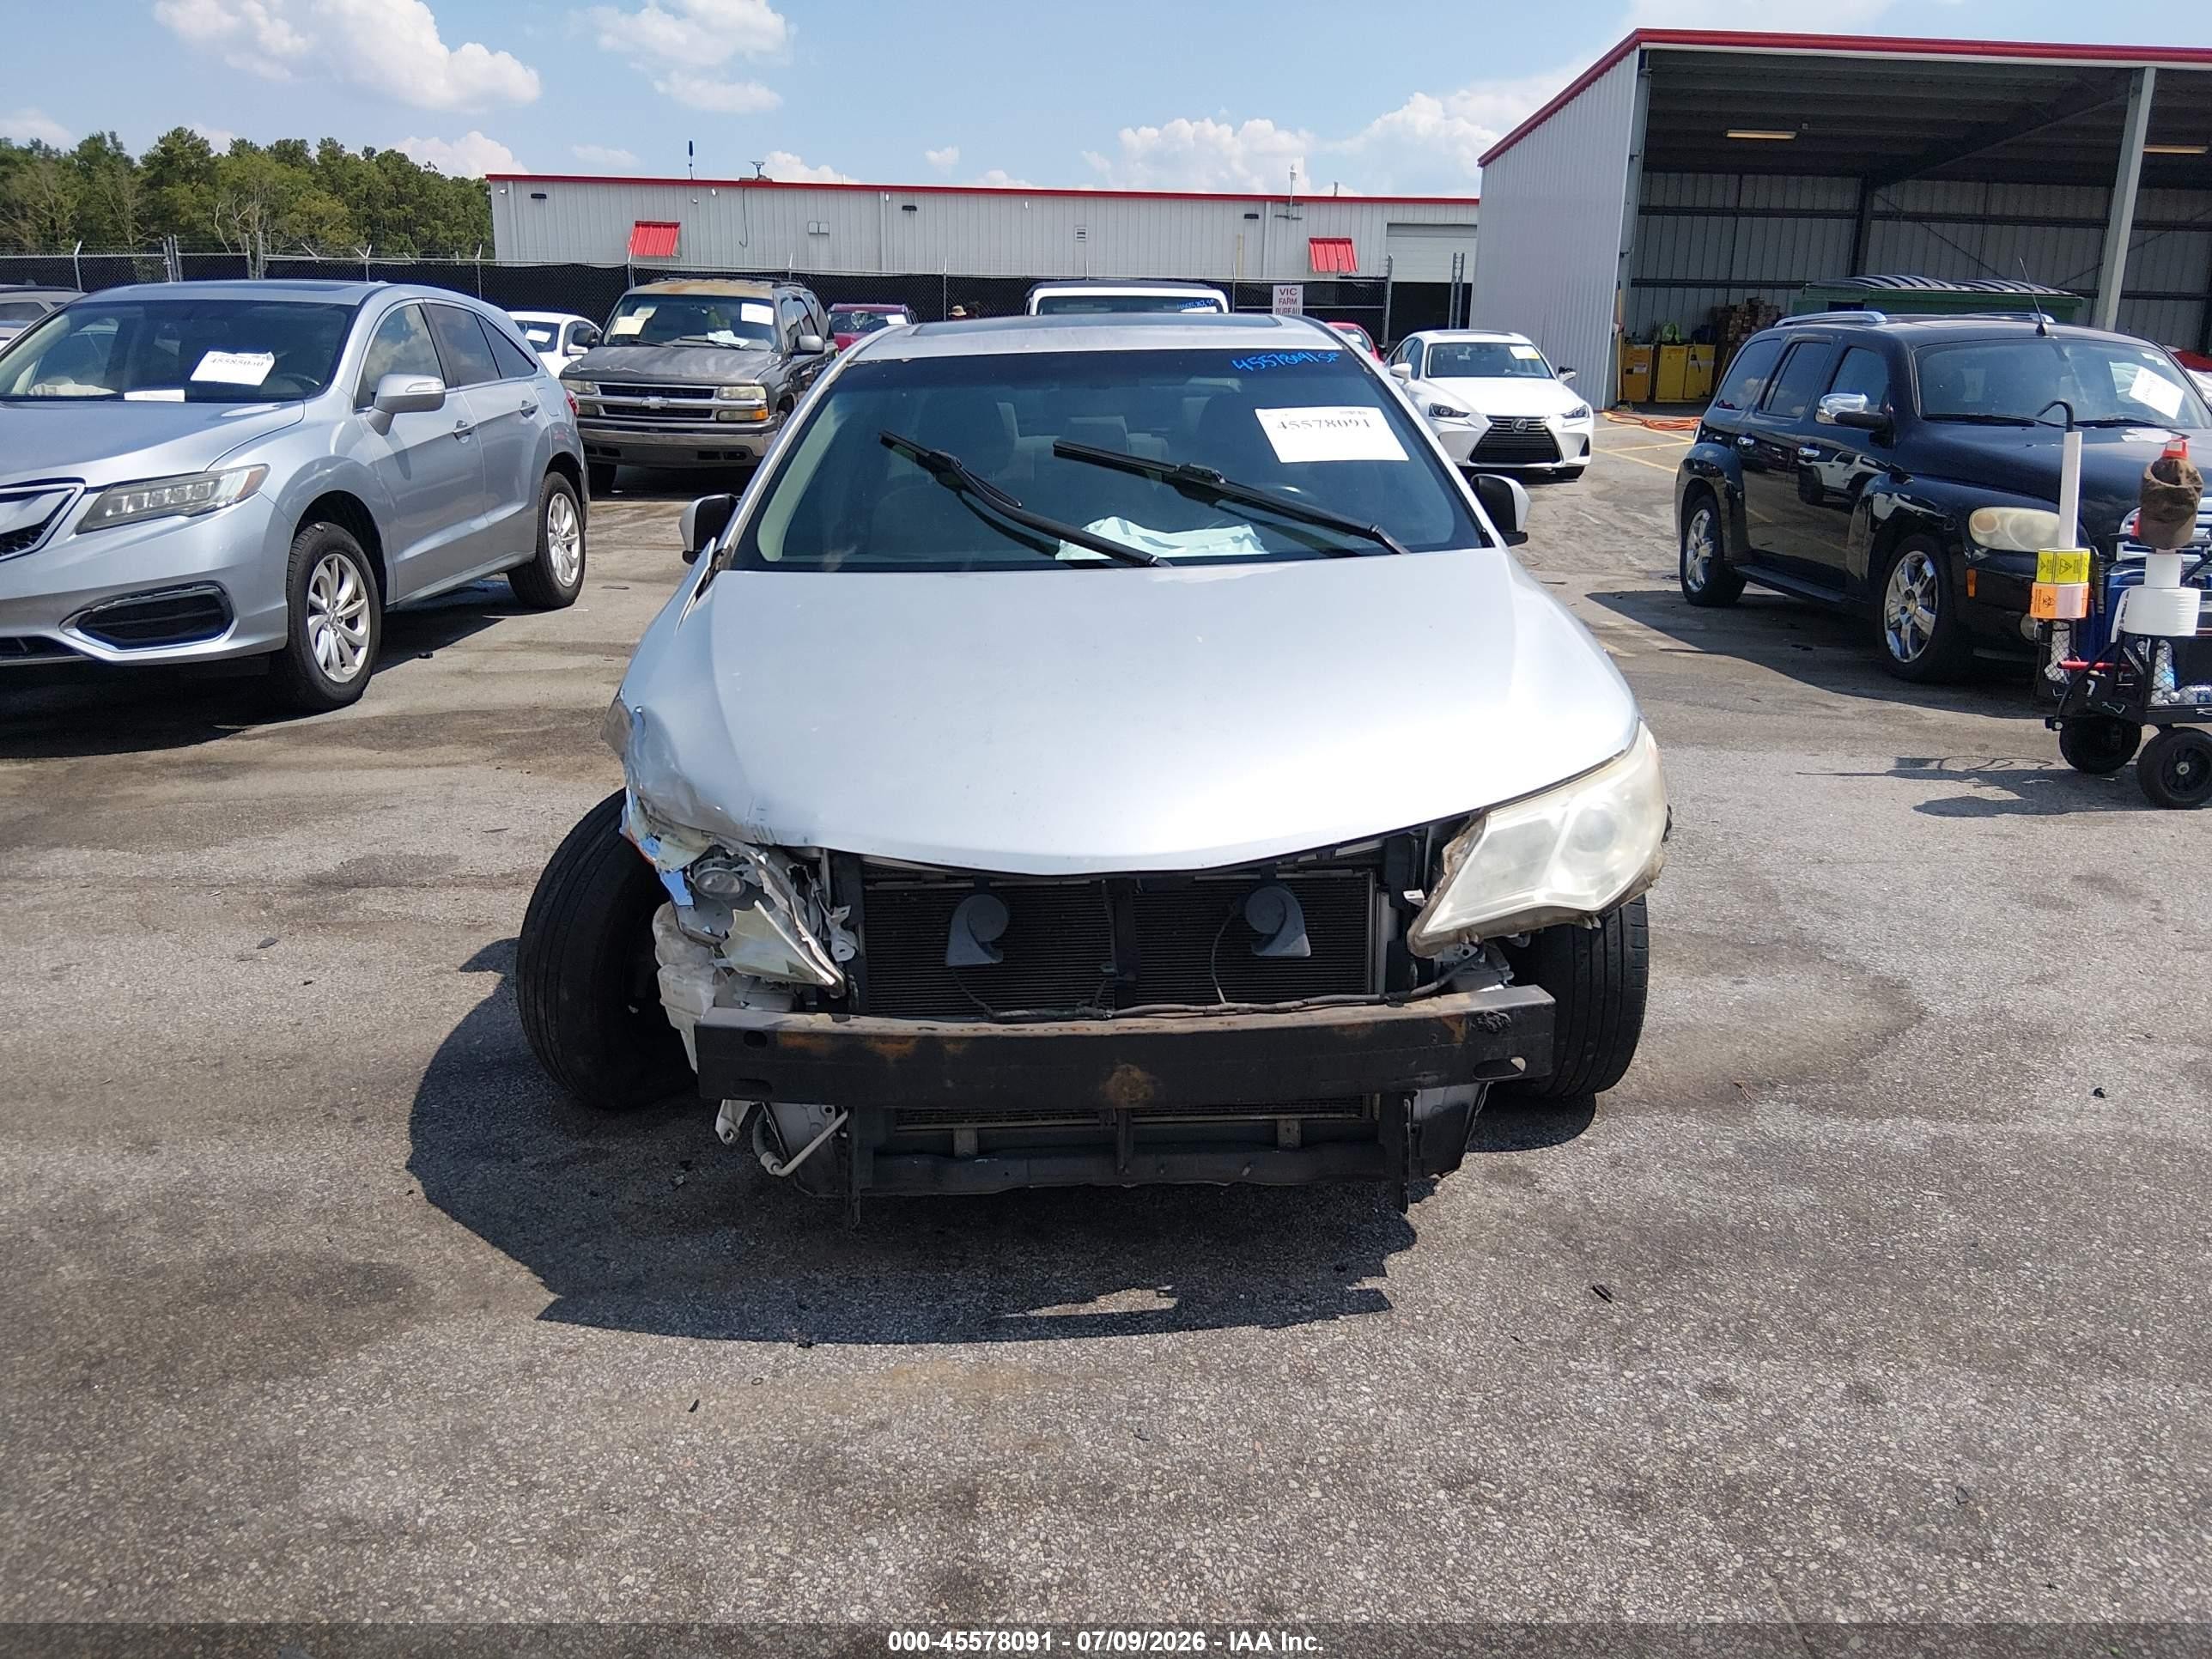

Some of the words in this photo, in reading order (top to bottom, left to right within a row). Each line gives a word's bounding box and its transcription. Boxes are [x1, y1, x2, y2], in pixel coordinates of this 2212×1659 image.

[1279, 288, 1297, 296] VIC
[1279, 297, 1297, 306] FARM
[1275, 307, 1300, 316] BUREAU
[1277, 418, 1371, 430] 45578091
